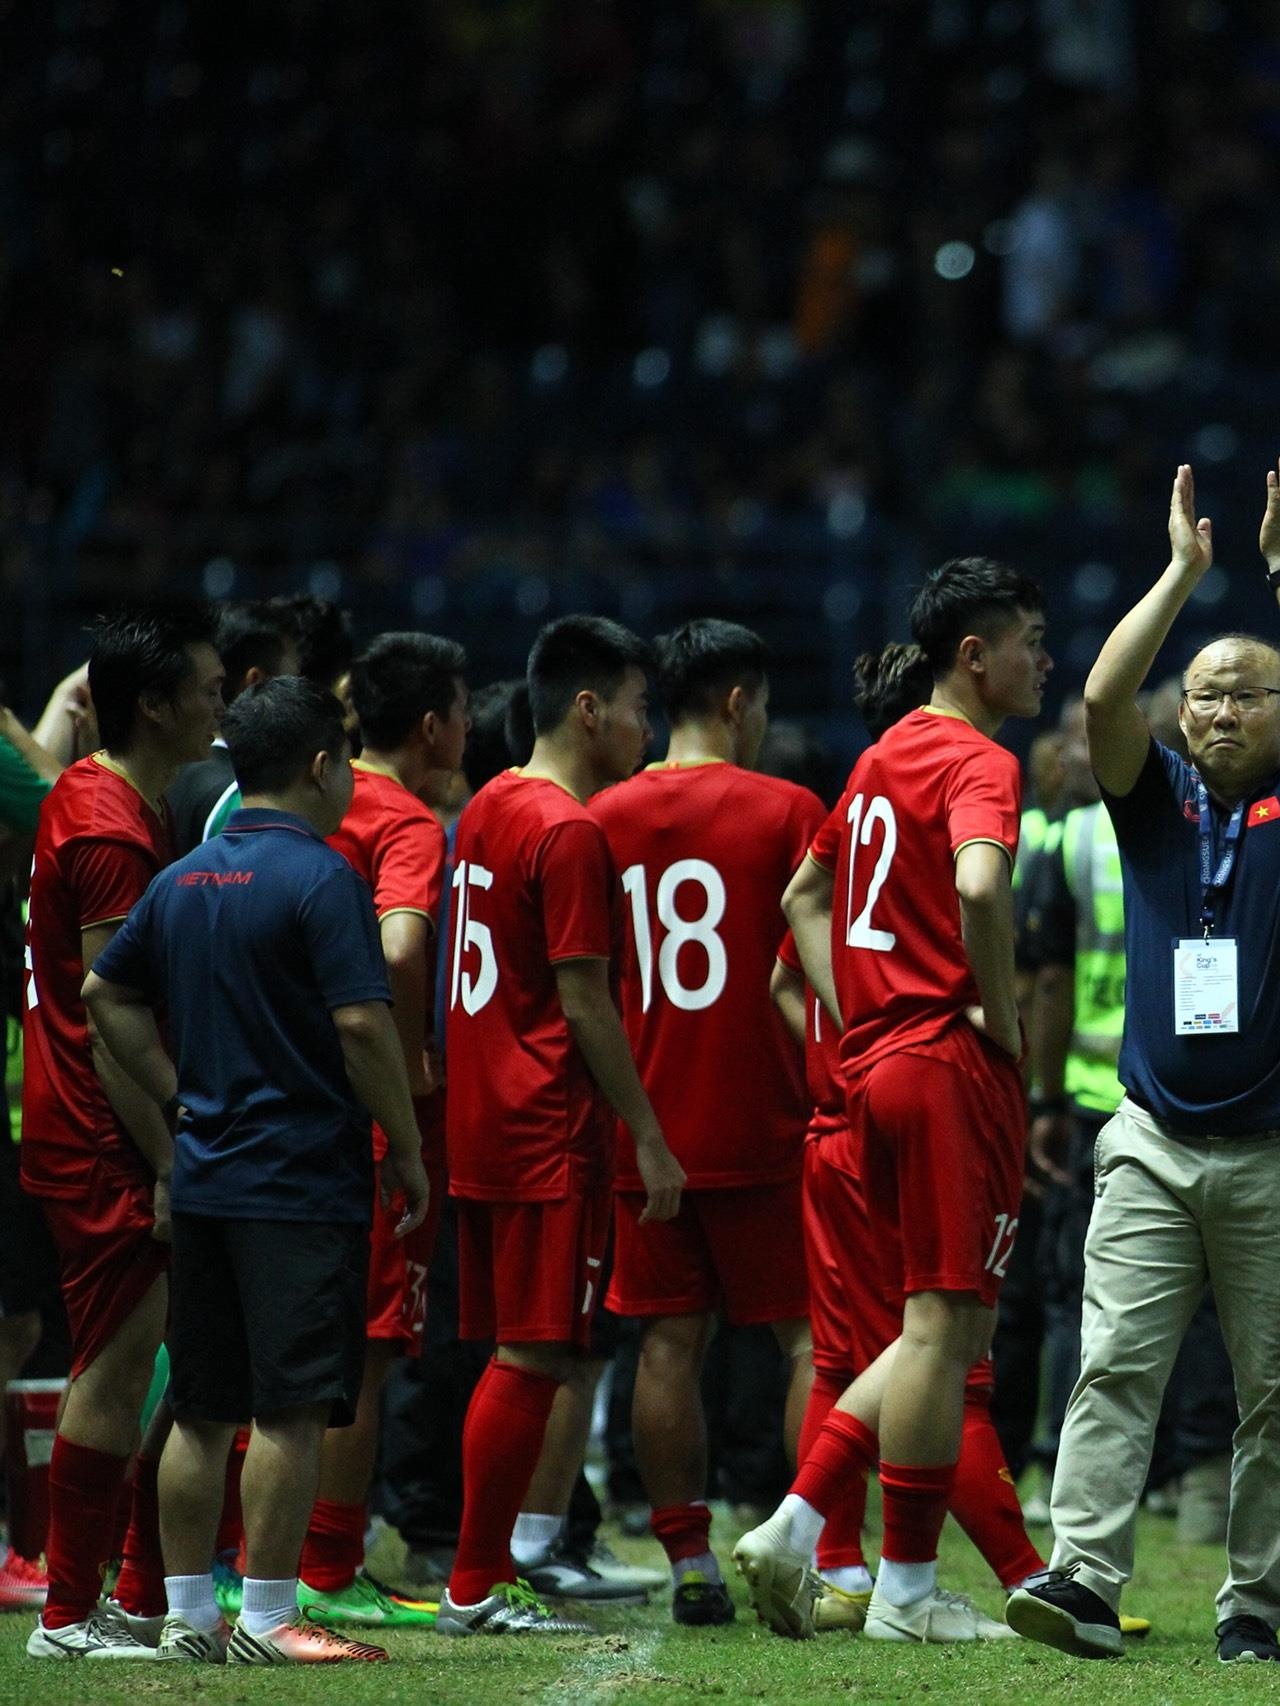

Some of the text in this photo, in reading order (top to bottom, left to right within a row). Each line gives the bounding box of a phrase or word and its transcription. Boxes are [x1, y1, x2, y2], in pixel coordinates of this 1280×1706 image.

[176, 871, 254, 887] VIETNAM
[452, 859, 498, 1016] 15
[621, 858, 728, 1014] 18
[846, 793, 897, 952] 12
[984, 1213, 1019, 1278] 12
